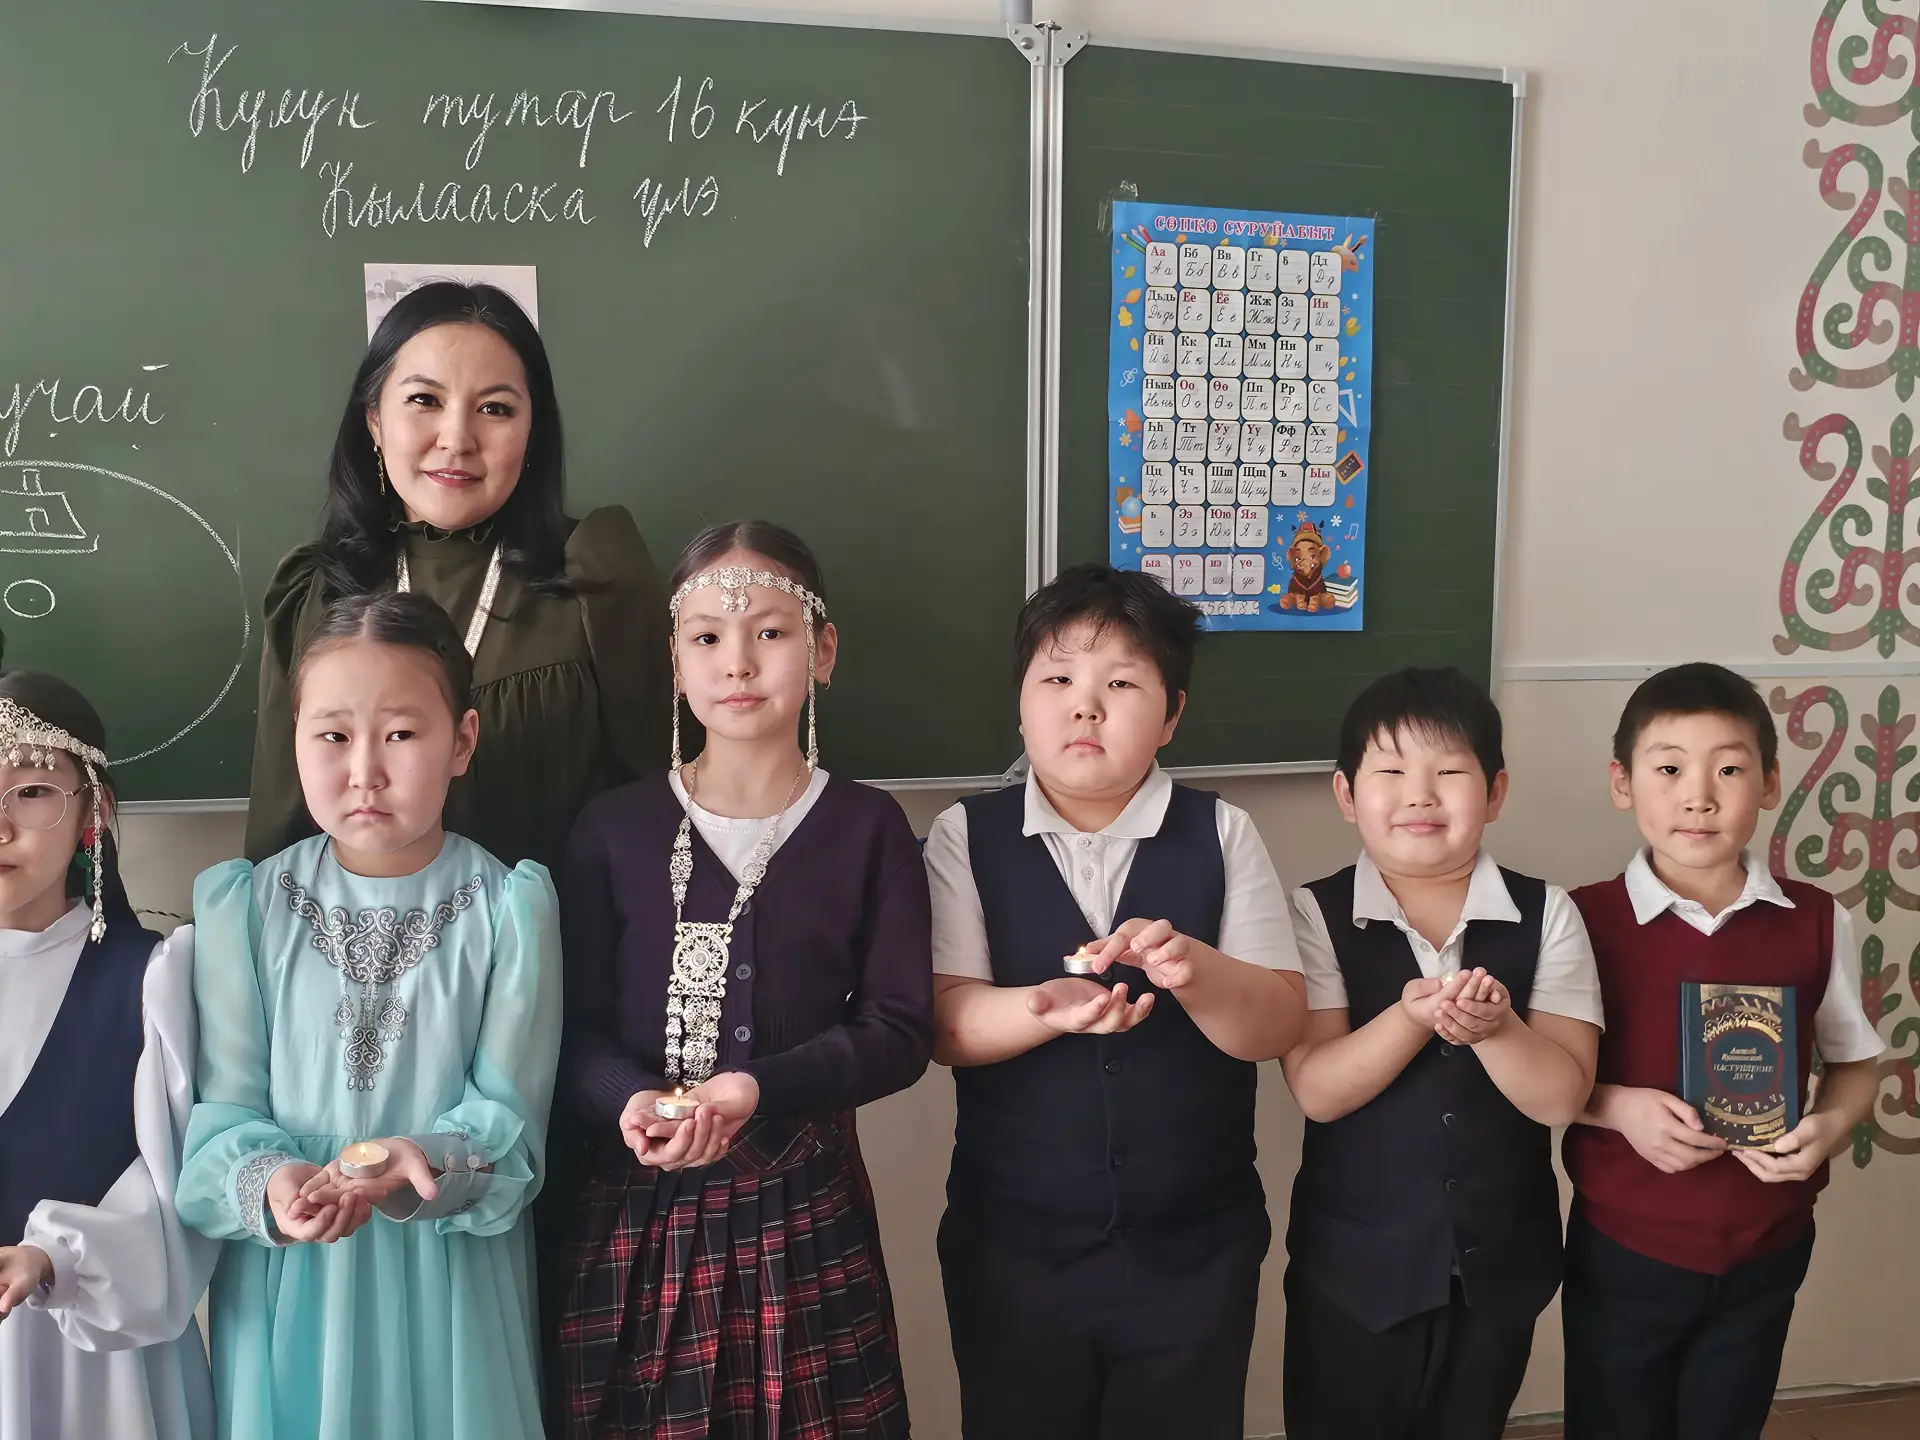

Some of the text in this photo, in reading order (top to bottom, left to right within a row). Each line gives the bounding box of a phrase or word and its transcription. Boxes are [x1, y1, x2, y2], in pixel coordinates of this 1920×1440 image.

[423, 88, 635, 170] тутар
[657, 75, 714, 142] 16
[319, 160, 596, 238] Кылааска
[1155, 216, 1335, 241] СӨПКӨ СУРУЙАБЫТ
[1151, 246, 1165, 256] Аа
[1184, 248, 1198, 258] Бб
[1217, 250, 1231, 260] Вв
[1251, 251, 1263, 261] Гг
[1313, 255, 1328, 267] Дд
[1148, 290, 1328, 308] Дьдь Ее Ёё Жж Зз Ии
[1148, 333, 1164, 345] Йй
[1181, 336, 1196, 346] Кк
[1215, 338, 1232, 348] Лл
[1248, 339, 1266, 349] Мм
[1280, 340, 1296, 350] Нн
[1145, 379, 1174, 390] Ньнь
[1180, 380, 1195, 390] Оо
[1246, 382, 1263, 392] Пп
[1280, 383, 1295, 395] Рр
[1313, 384, 1325, 394] Сс
[1182, 422, 1196, 432] Тт
[1215, 423, 1230, 435] Уу
[1277, 425, 1296, 437] Фф
[1310, 426, 1326, 435] Хх
[1146, 465, 1162, 476] Цц
[1179, 466, 1194, 475] Чч
[1211, 466, 1233, 476] Шш
[1243, 467, 1266, 478] Щщ
[1310, 468, 1330, 478] Ыы
[1179, 509, 1192, 518] Ээ
[1211, 509, 1232, 519] Юю
[1241, 509, 1257, 519] Яя
